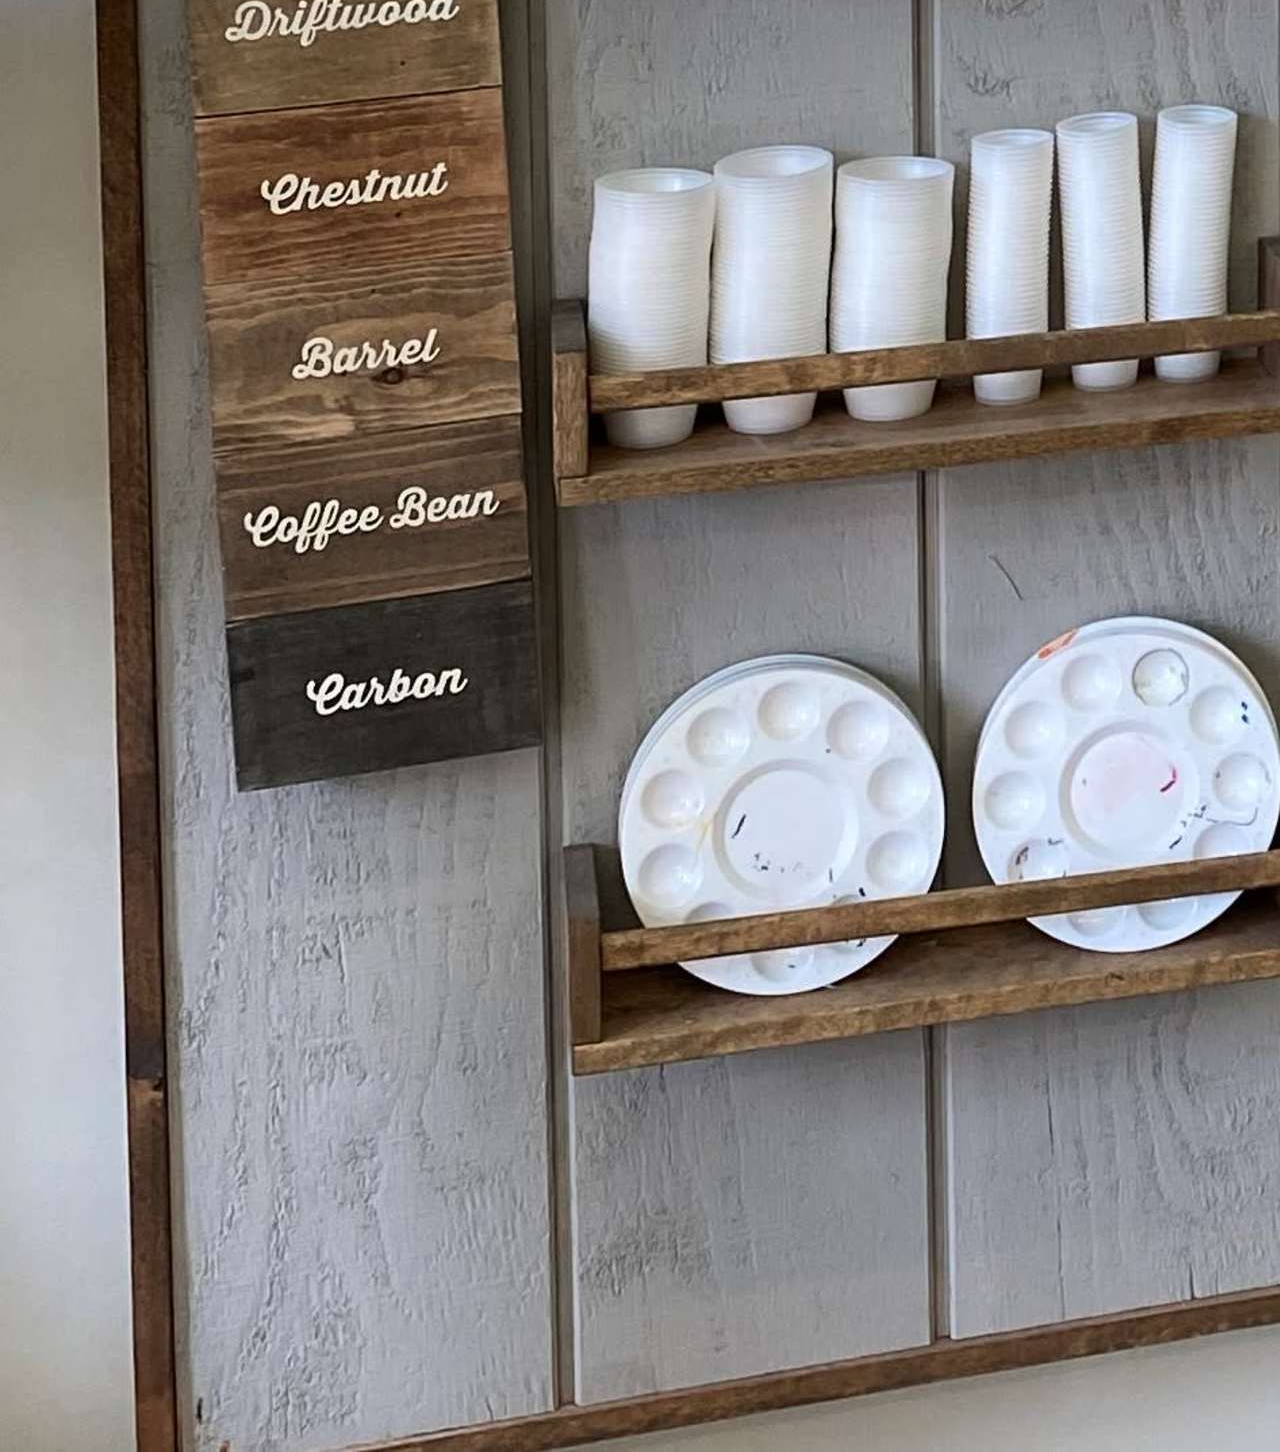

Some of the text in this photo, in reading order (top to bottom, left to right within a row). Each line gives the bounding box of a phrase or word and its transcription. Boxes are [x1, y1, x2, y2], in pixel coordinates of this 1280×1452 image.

[260, 161, 449, 214] Chestnut
[291, 330, 438, 383] Barrel
[244, 486, 499, 553] Coffee Bean
[305, 665, 468, 716] Carbon
